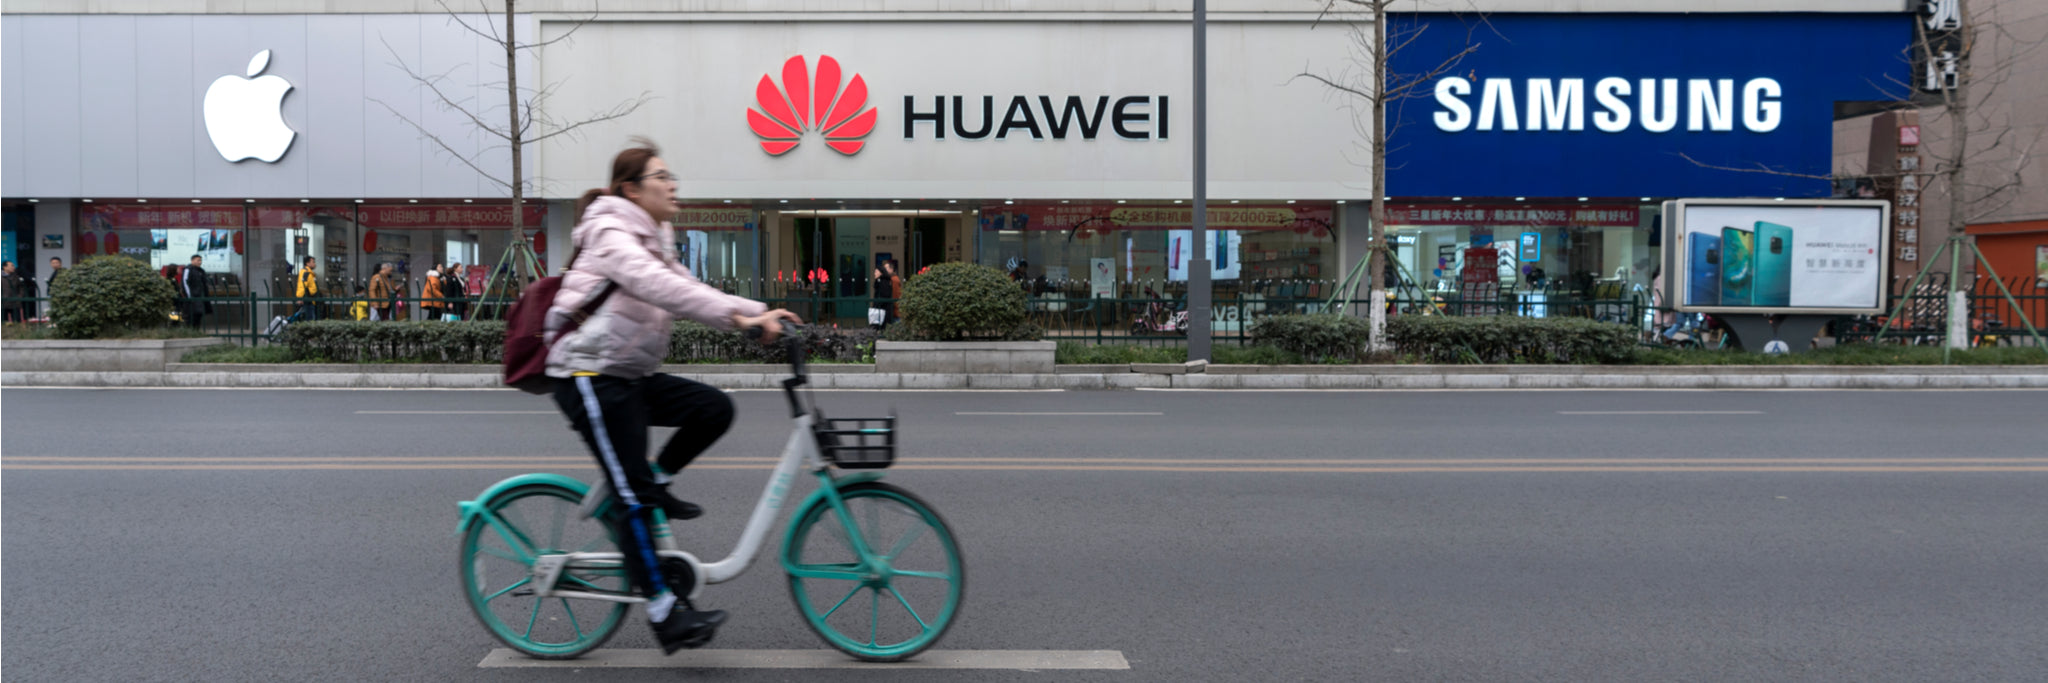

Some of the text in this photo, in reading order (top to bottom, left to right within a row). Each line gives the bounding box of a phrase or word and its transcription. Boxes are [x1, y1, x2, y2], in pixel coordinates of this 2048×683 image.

[903, 94, 1168, 140] HUAWEI
[1433, 76, 1782, 133] SAMSUNG
[1129, 211, 1279, 223] 全场购机最直降2000元
